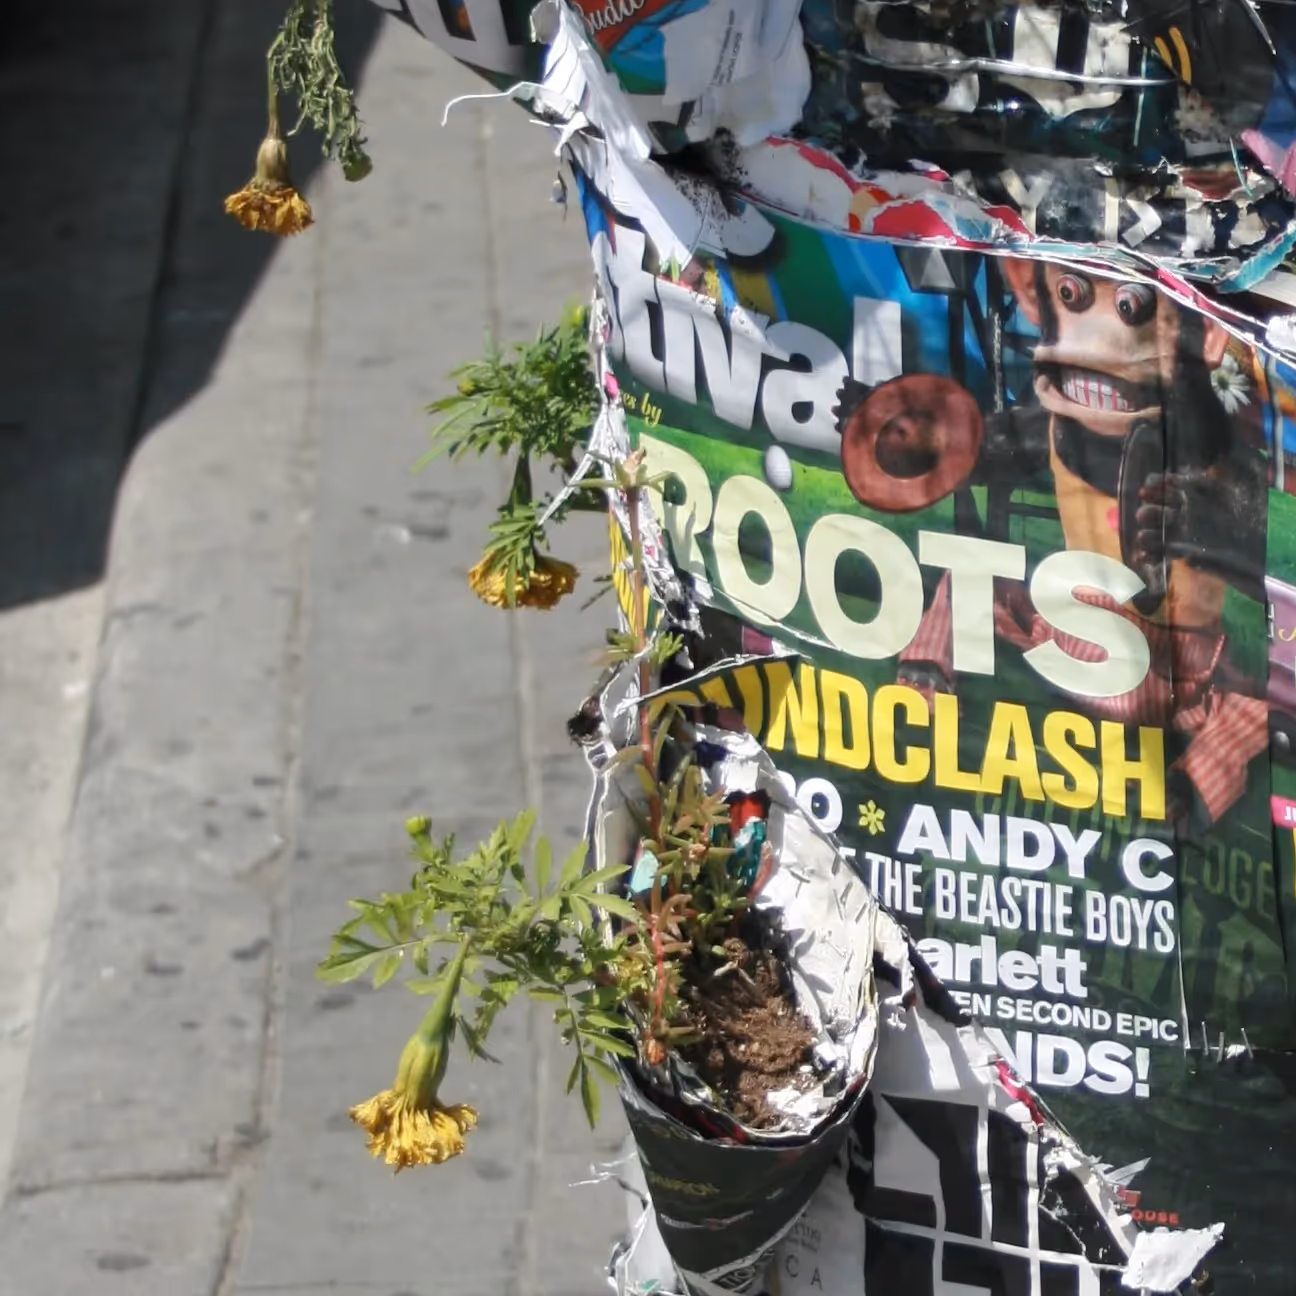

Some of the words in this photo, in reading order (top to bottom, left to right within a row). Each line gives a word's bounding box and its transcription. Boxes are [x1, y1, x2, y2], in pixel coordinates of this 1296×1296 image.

[898, 802, 1103, 879] ANDY
[1122, 837, 1175, 892] C
[934, 865, 1081, 938] BEASTIE
[1085, 892, 1177, 954] BOYS
[996, 995, 1112, 1032] SECOND
[1115, 1011, 1179, 1042] EPIC
